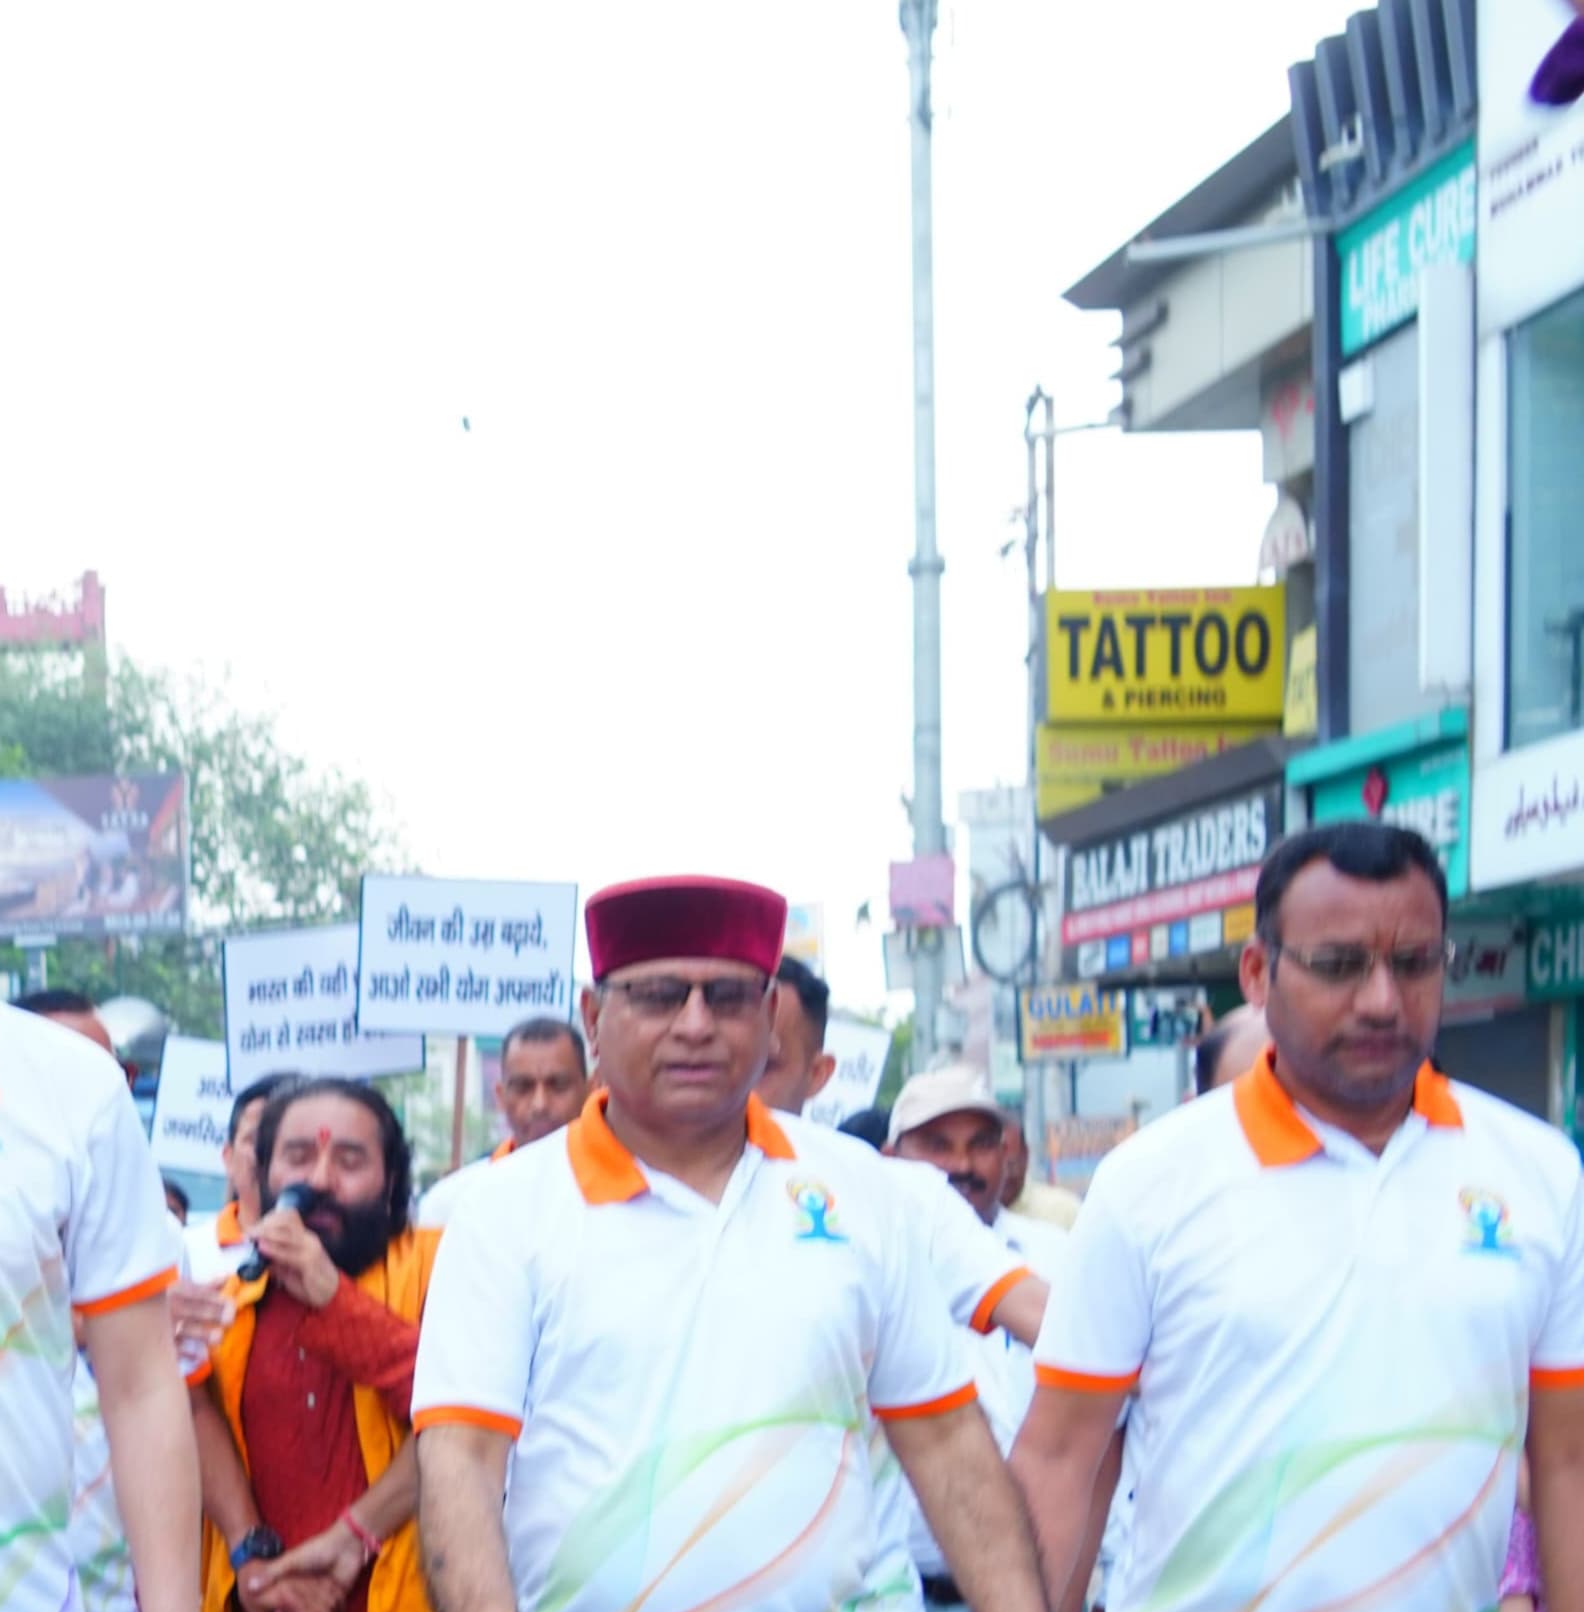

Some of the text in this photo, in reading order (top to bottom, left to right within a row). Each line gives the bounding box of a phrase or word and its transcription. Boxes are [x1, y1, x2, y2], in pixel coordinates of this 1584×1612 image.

[1349, 217, 1400, 312] LIFE
[1408, 163, 1476, 268] CURE
[1058, 611, 1271, 681] TATTOO
[1125, 688, 1227, 710] PIERCING
[1072, 833, 1149, 911] BALAJI
[1153, 797, 1266, 888] TRADERS
[387, 902, 436, 943] जीवन
[441, 904, 465, 944] की
[293, 965, 315, 998] की
[416, 962, 451, 1003] सभी
[456, 965, 490, 1004] योग
